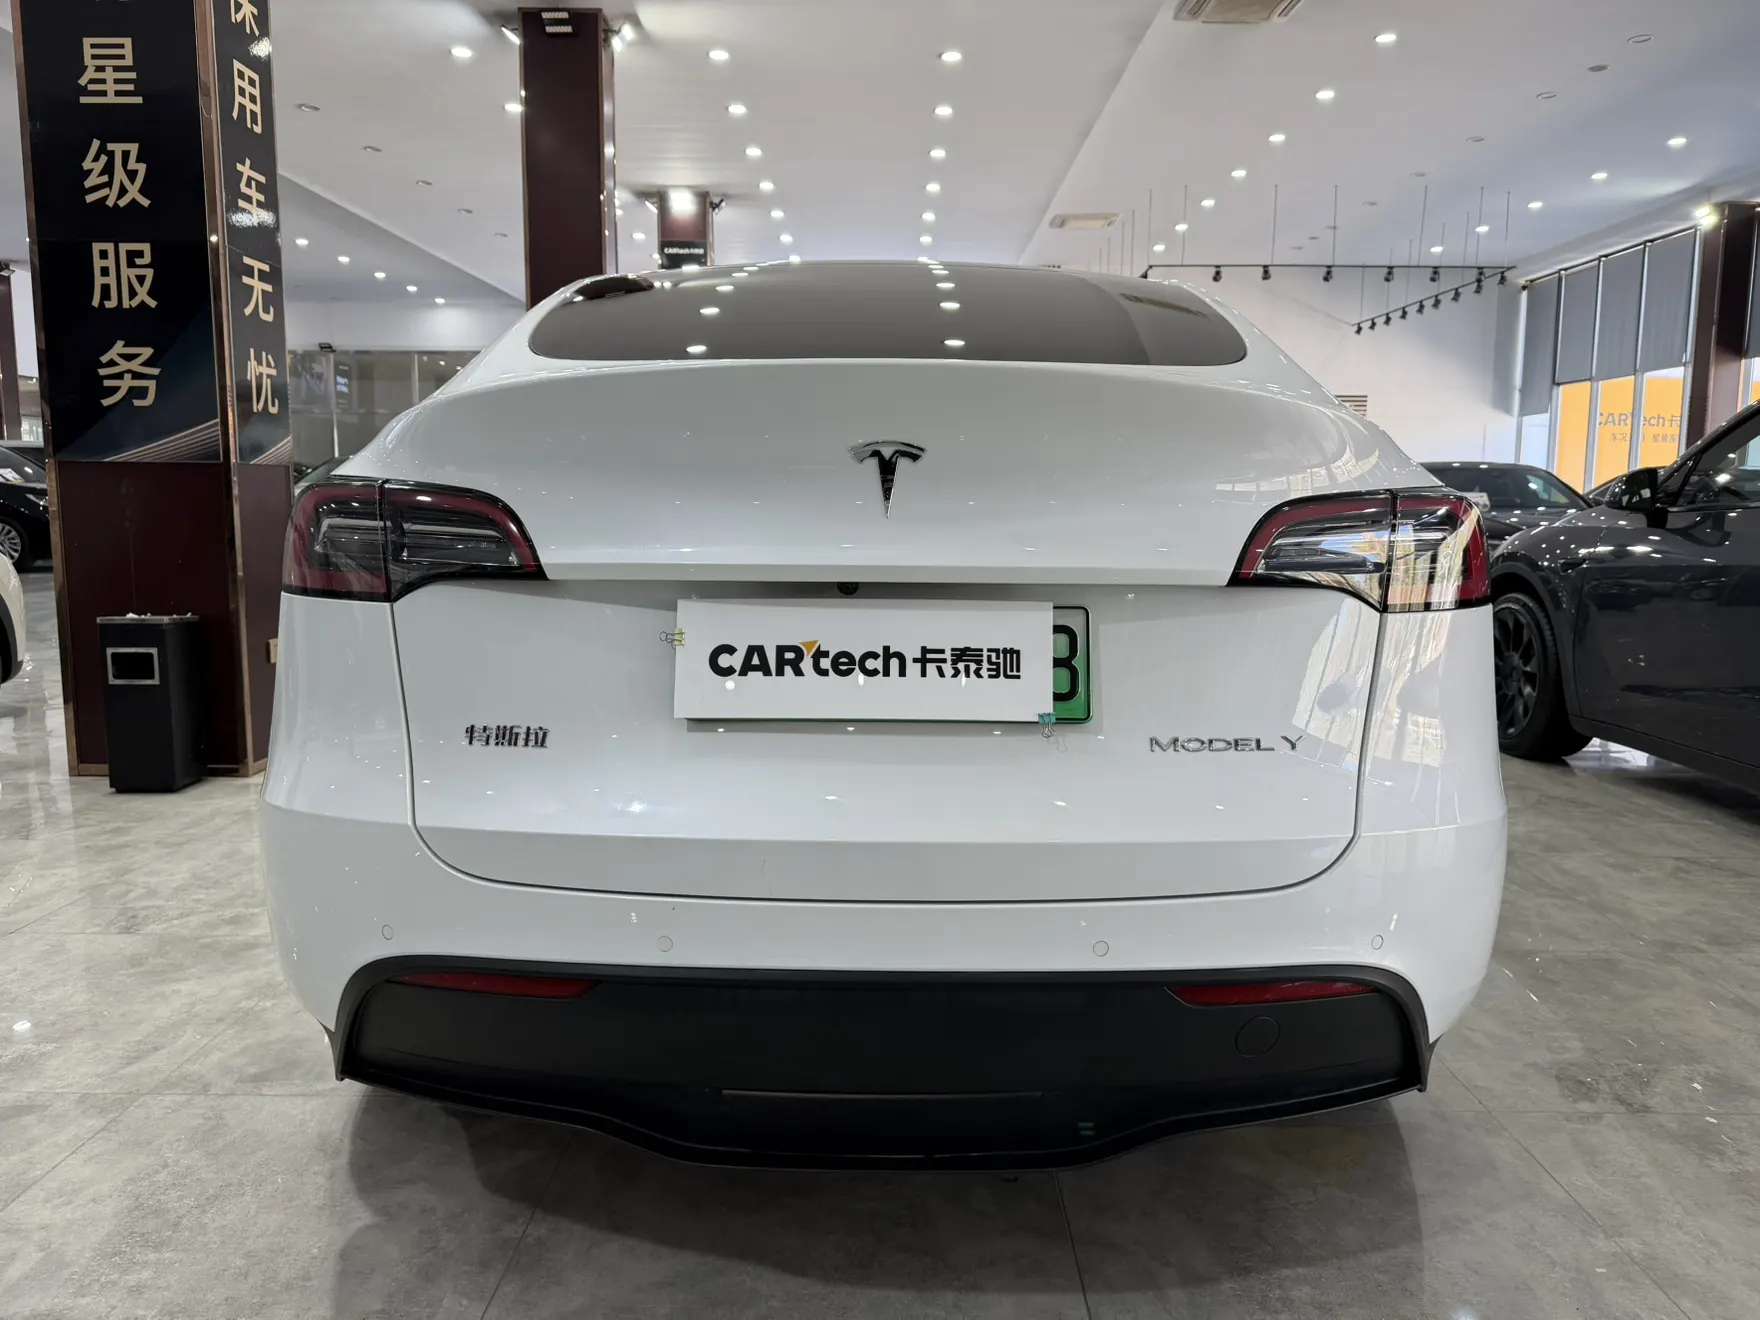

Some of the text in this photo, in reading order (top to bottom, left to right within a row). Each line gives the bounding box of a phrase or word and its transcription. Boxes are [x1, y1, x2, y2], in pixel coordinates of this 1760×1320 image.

[77, 37, 162, 408] 星级服务
[912, 645, 1021, 680] 卡泰驰
[464, 724, 550, 748] 特斯拉
[1149, 735, 1304, 752] MODEL Y
